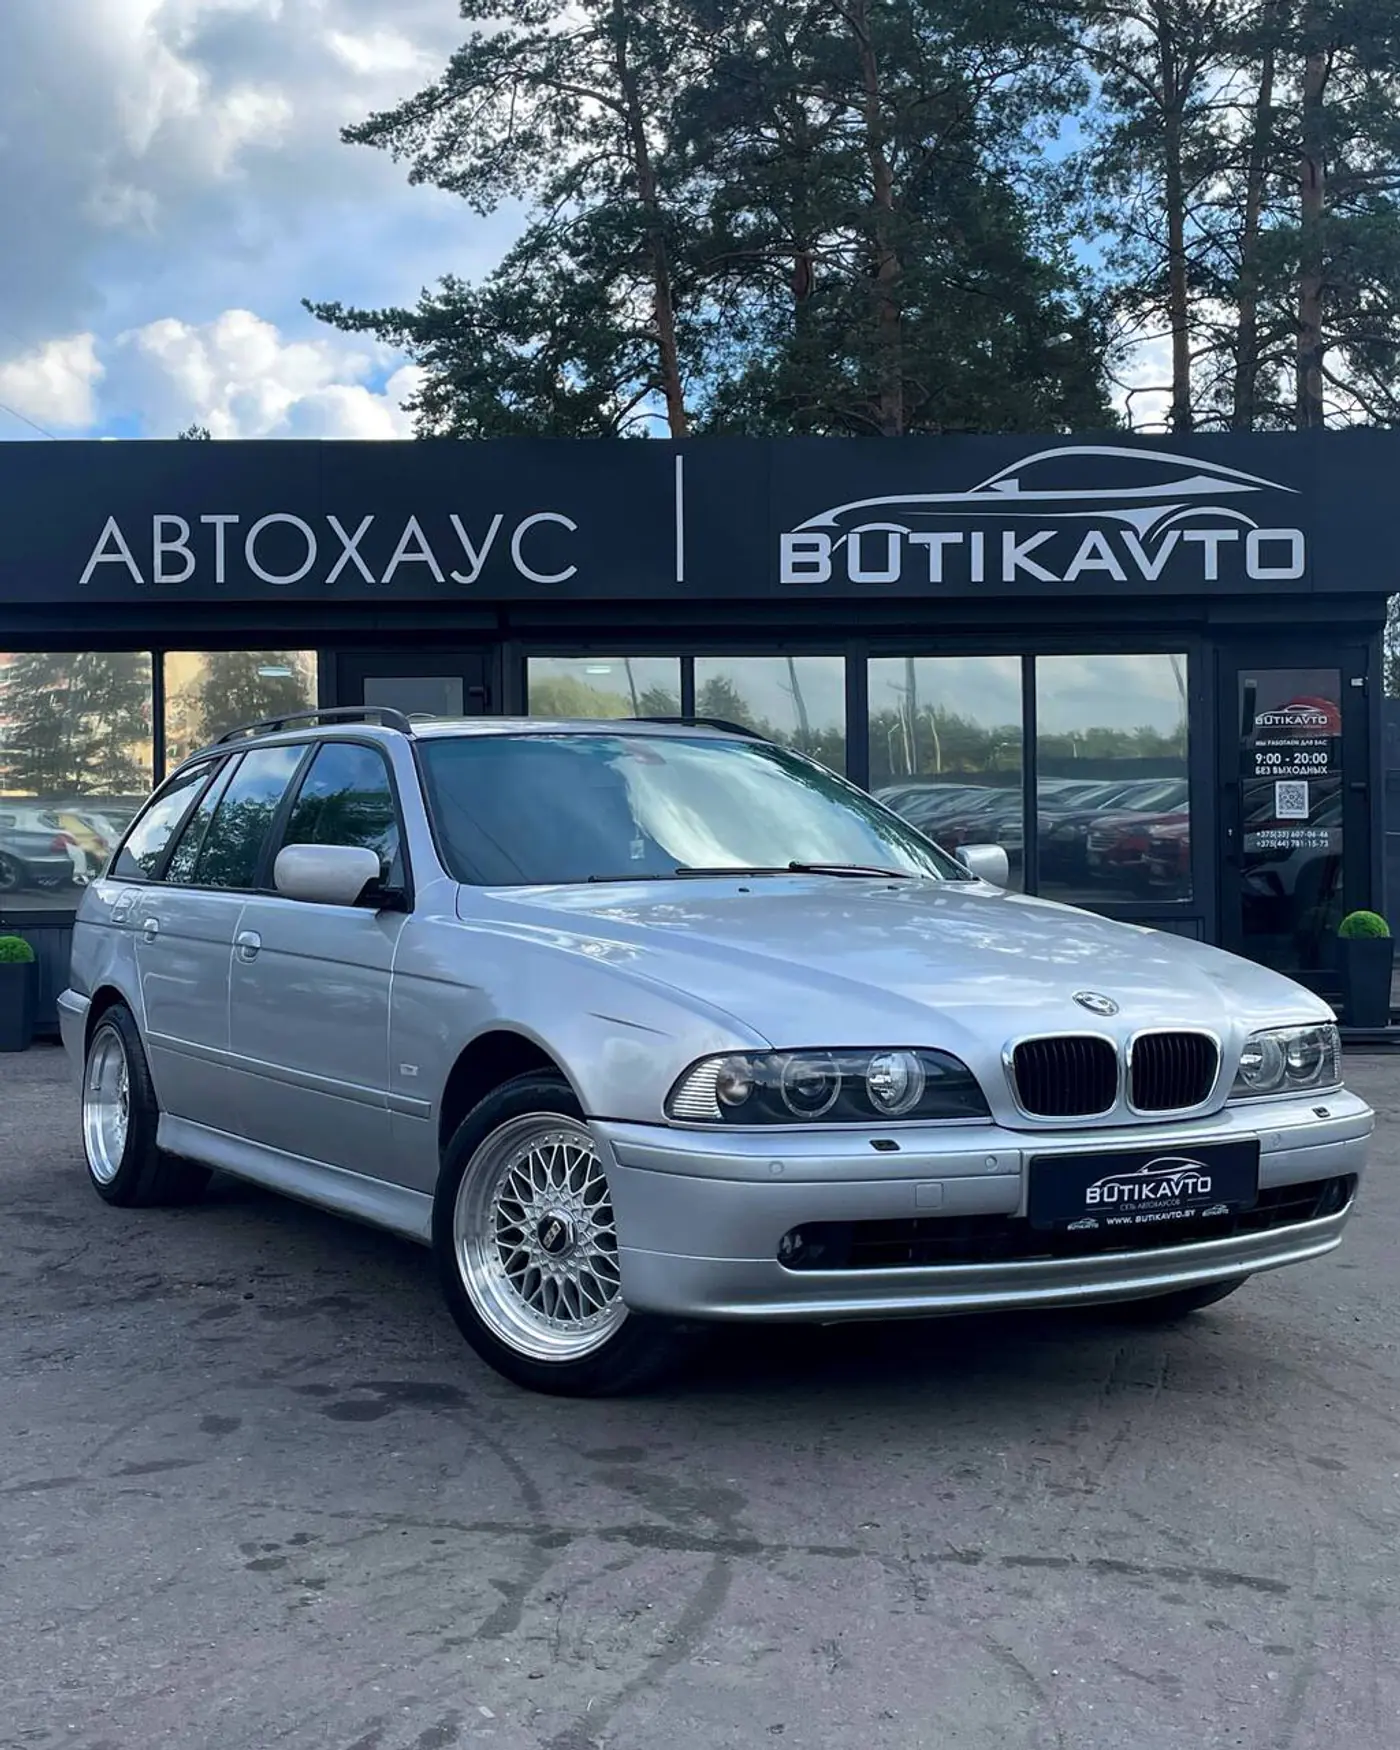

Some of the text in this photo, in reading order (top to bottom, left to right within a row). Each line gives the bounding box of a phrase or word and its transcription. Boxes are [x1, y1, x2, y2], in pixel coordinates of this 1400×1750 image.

[79, 513, 578, 585] АВТОХАУС
[780, 527, 1305, 584] BUTIKAVTO
[1255, 753, 1281, 764] 9:00
[1294, 753, 1328, 764] 20:00
[1255, 766, 1328, 775] БЕЗ ВЫХОДНЫХ
[1085, 1176, 1211, 1204] BUTIKAVTO
